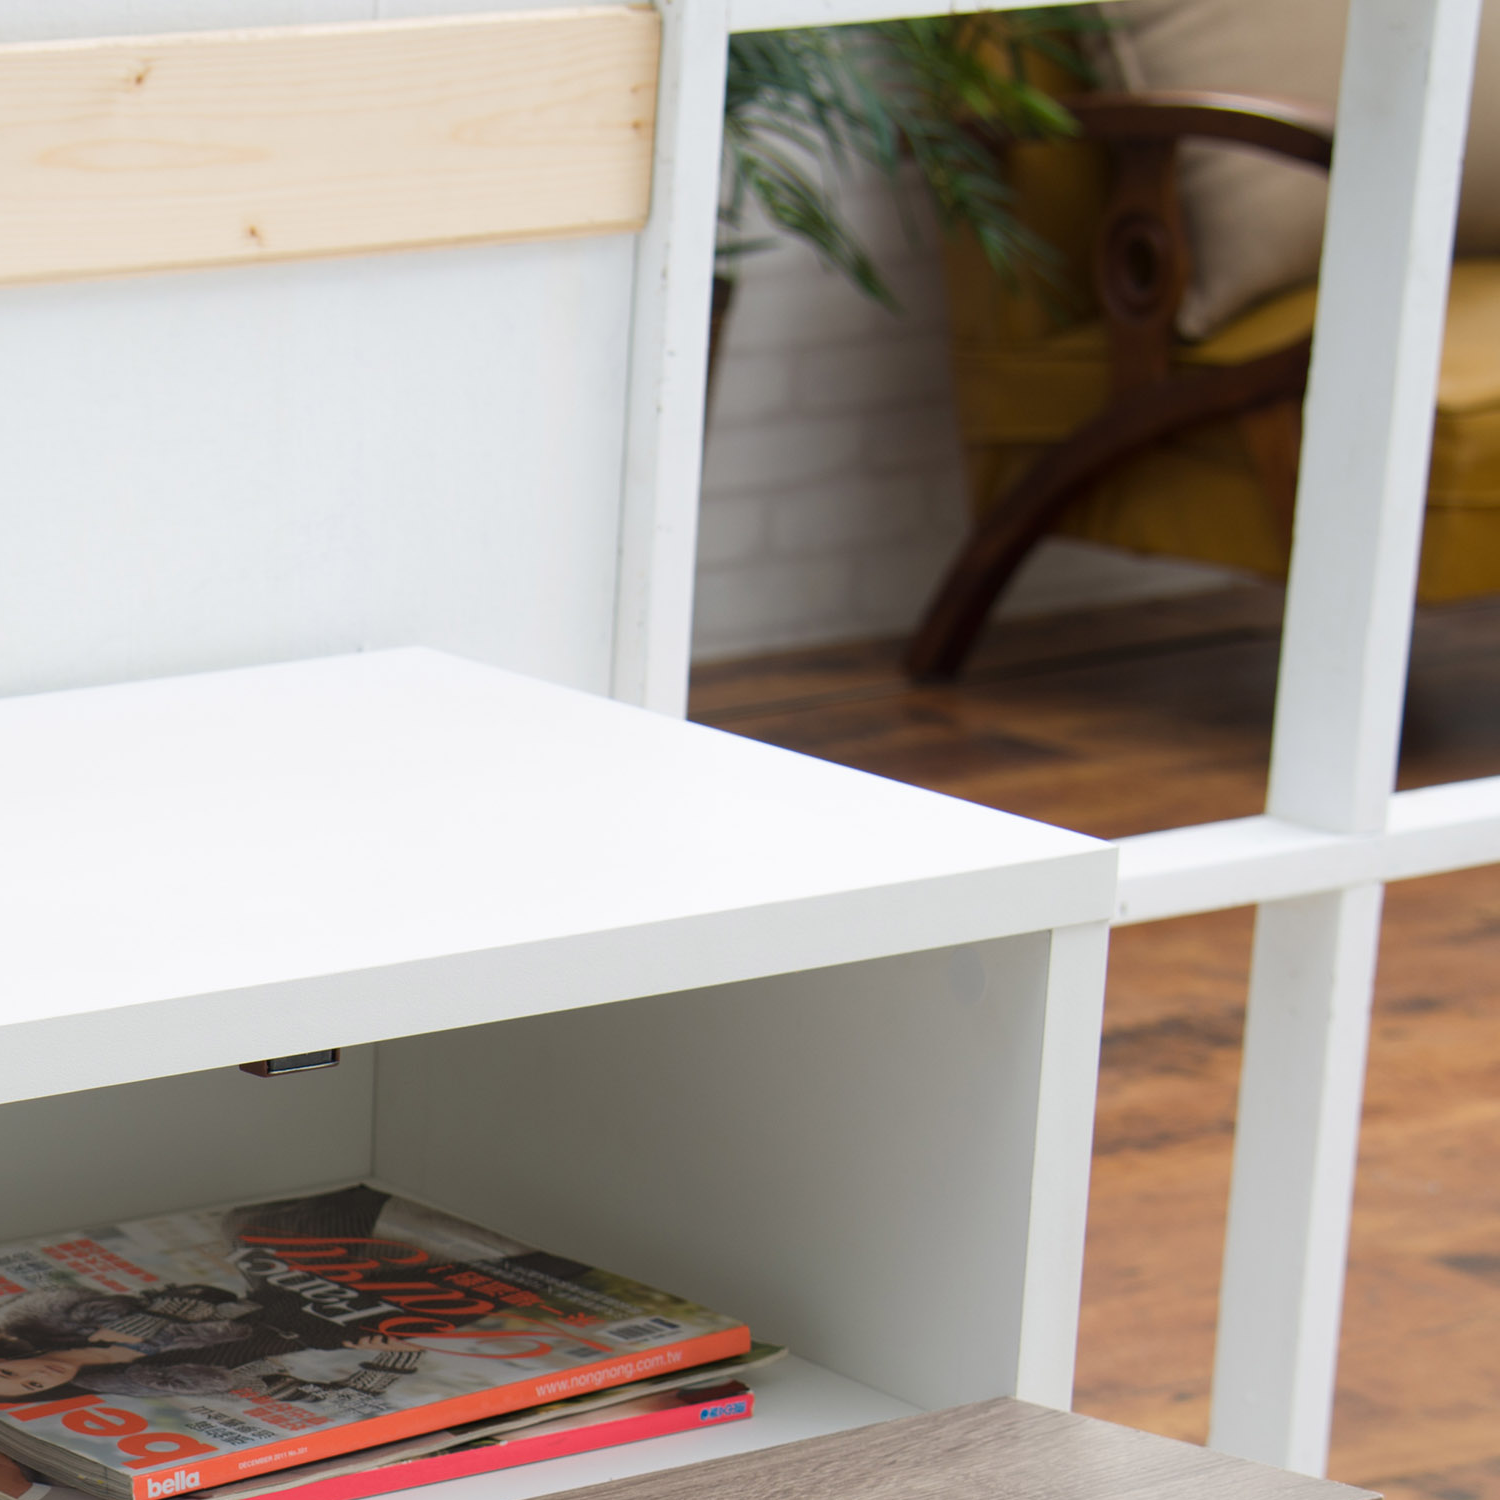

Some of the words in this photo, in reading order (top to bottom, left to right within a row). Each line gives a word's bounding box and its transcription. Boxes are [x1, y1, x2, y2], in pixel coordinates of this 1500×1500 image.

[225, 1246, 405, 1327] Fancy
[238, 1228, 613, 1359] Party
[535, 1351, 682, 1397] www.nongnong.com.tw
[147, 1470, 200, 1499] bella
[238, 1455, 273, 1471] DECEMBER
